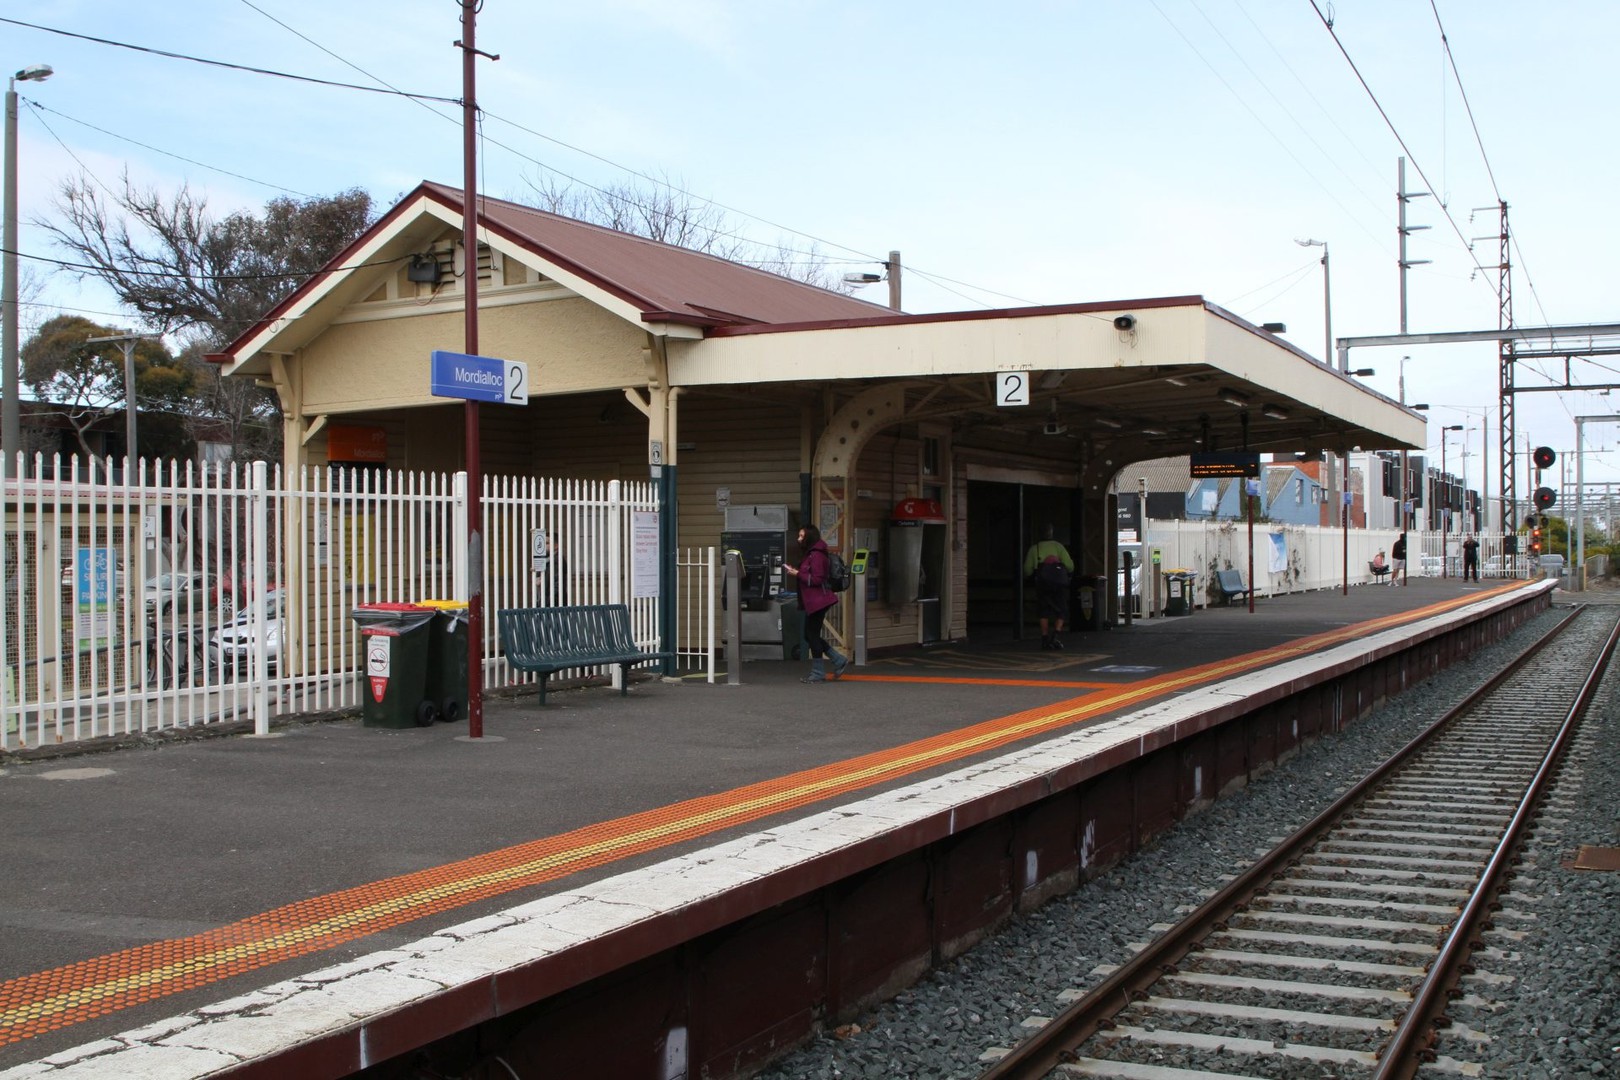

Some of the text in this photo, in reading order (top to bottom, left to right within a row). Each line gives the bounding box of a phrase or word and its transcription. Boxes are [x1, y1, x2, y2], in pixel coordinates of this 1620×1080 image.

[455, 365, 524, 401] Mordialloc 2
[1004, 374, 1022, 403] 2
